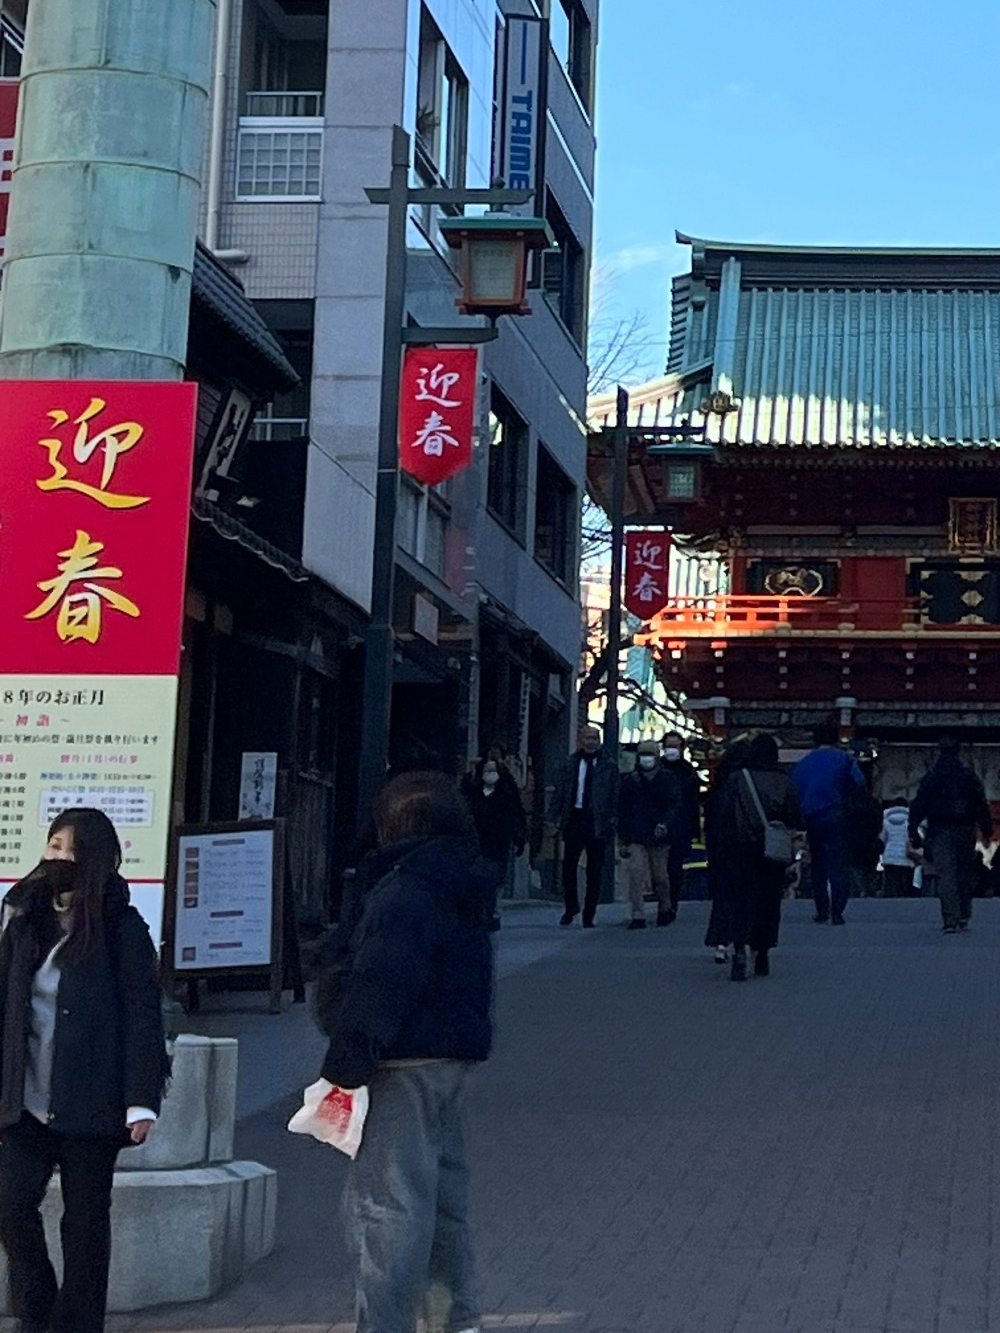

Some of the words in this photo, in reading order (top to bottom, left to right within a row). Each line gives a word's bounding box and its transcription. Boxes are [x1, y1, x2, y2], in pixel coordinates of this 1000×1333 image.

[415, 363, 461, 456] 迎春
[25, 398, 151, 644] 迎春
[632, 541, 664, 602] 迎春
